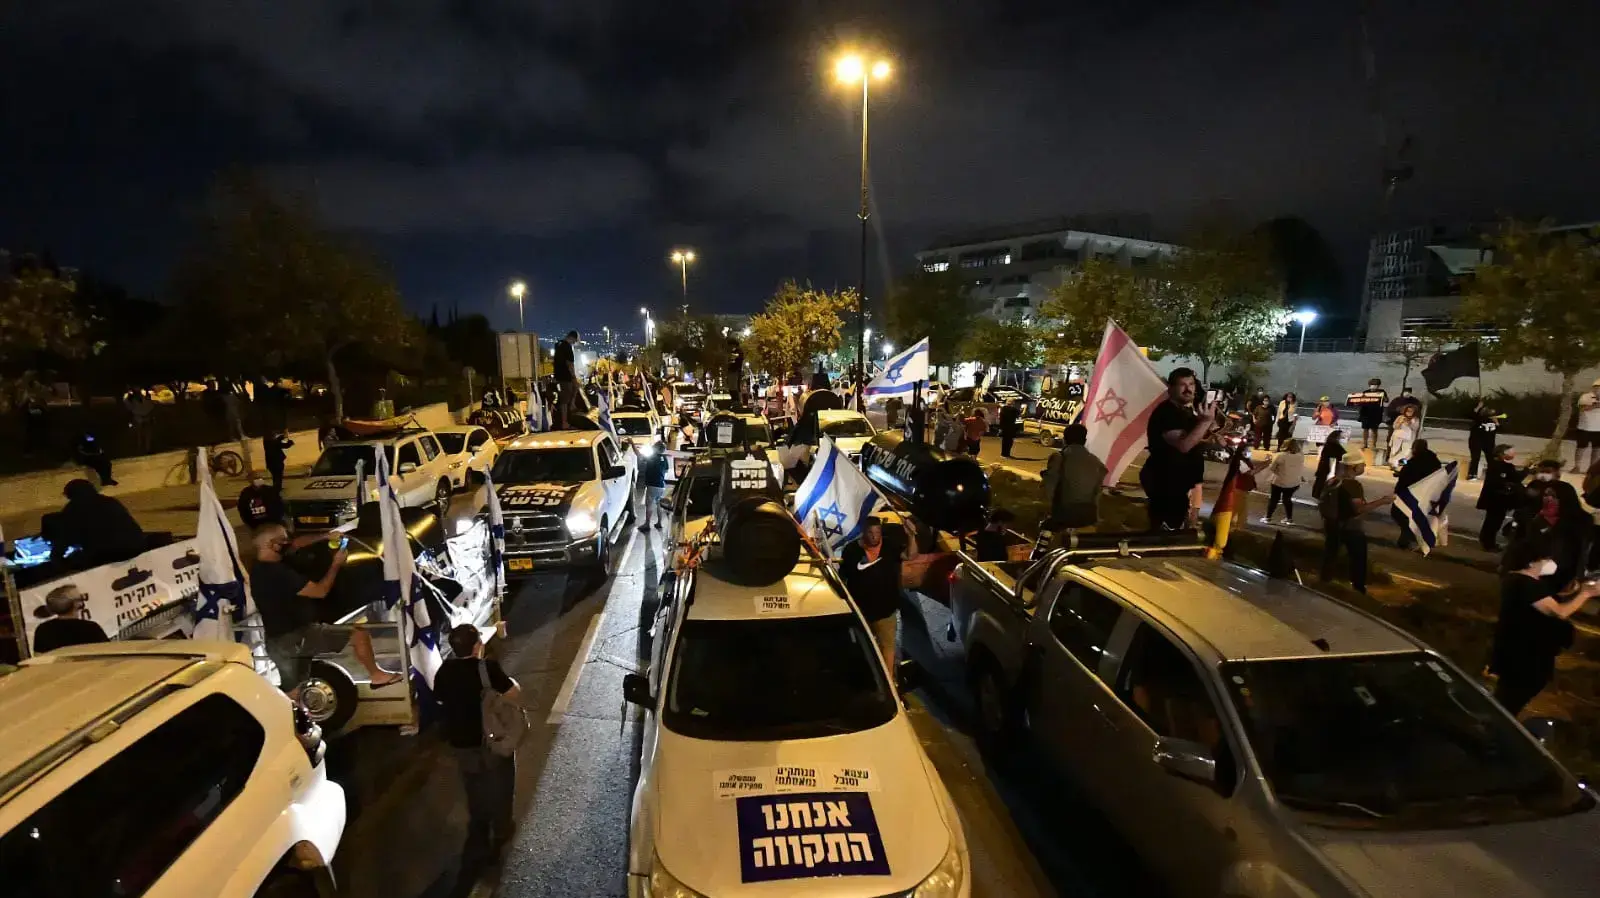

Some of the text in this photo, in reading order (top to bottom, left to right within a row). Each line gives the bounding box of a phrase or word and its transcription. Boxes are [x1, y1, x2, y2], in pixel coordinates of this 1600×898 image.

[731, 469, 767, 480] חקירה
[731, 480, 767, 490] עכשיו
[114, 582, 157, 609] חקירה
[761, 801, 852, 831] אנחנו
[752, 832, 875, 868] התקווה
